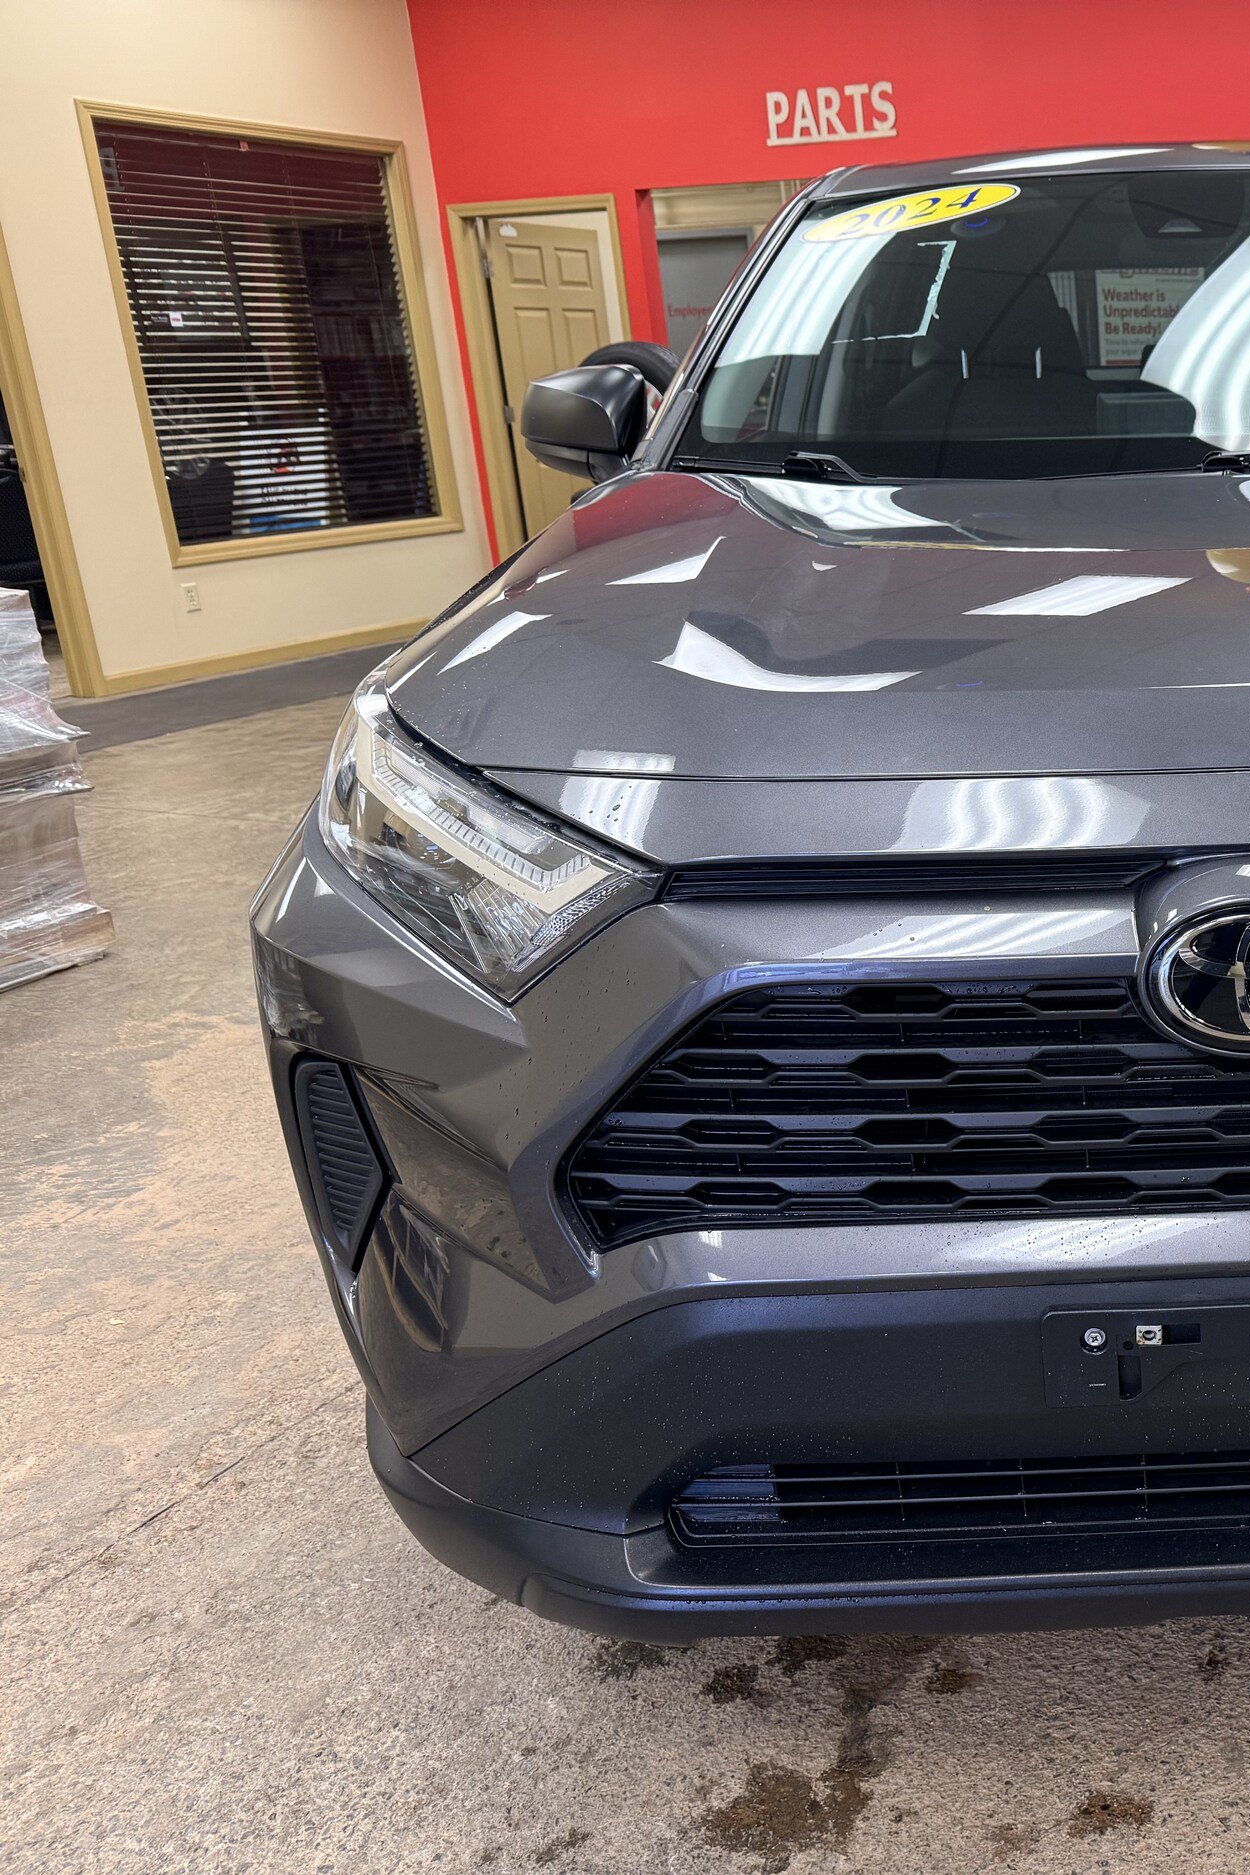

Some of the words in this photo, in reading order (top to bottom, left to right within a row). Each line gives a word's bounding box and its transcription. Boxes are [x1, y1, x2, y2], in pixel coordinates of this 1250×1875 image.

[766, 81, 896, 141] PARTS
[839, 187, 984, 236] 2024
[1102, 288, 1154, 302] Weather
[1156, 288, 1166, 302] is
[1104, 322, 1119, 335] Be
[1122, 322, 1161, 338] Ready!
